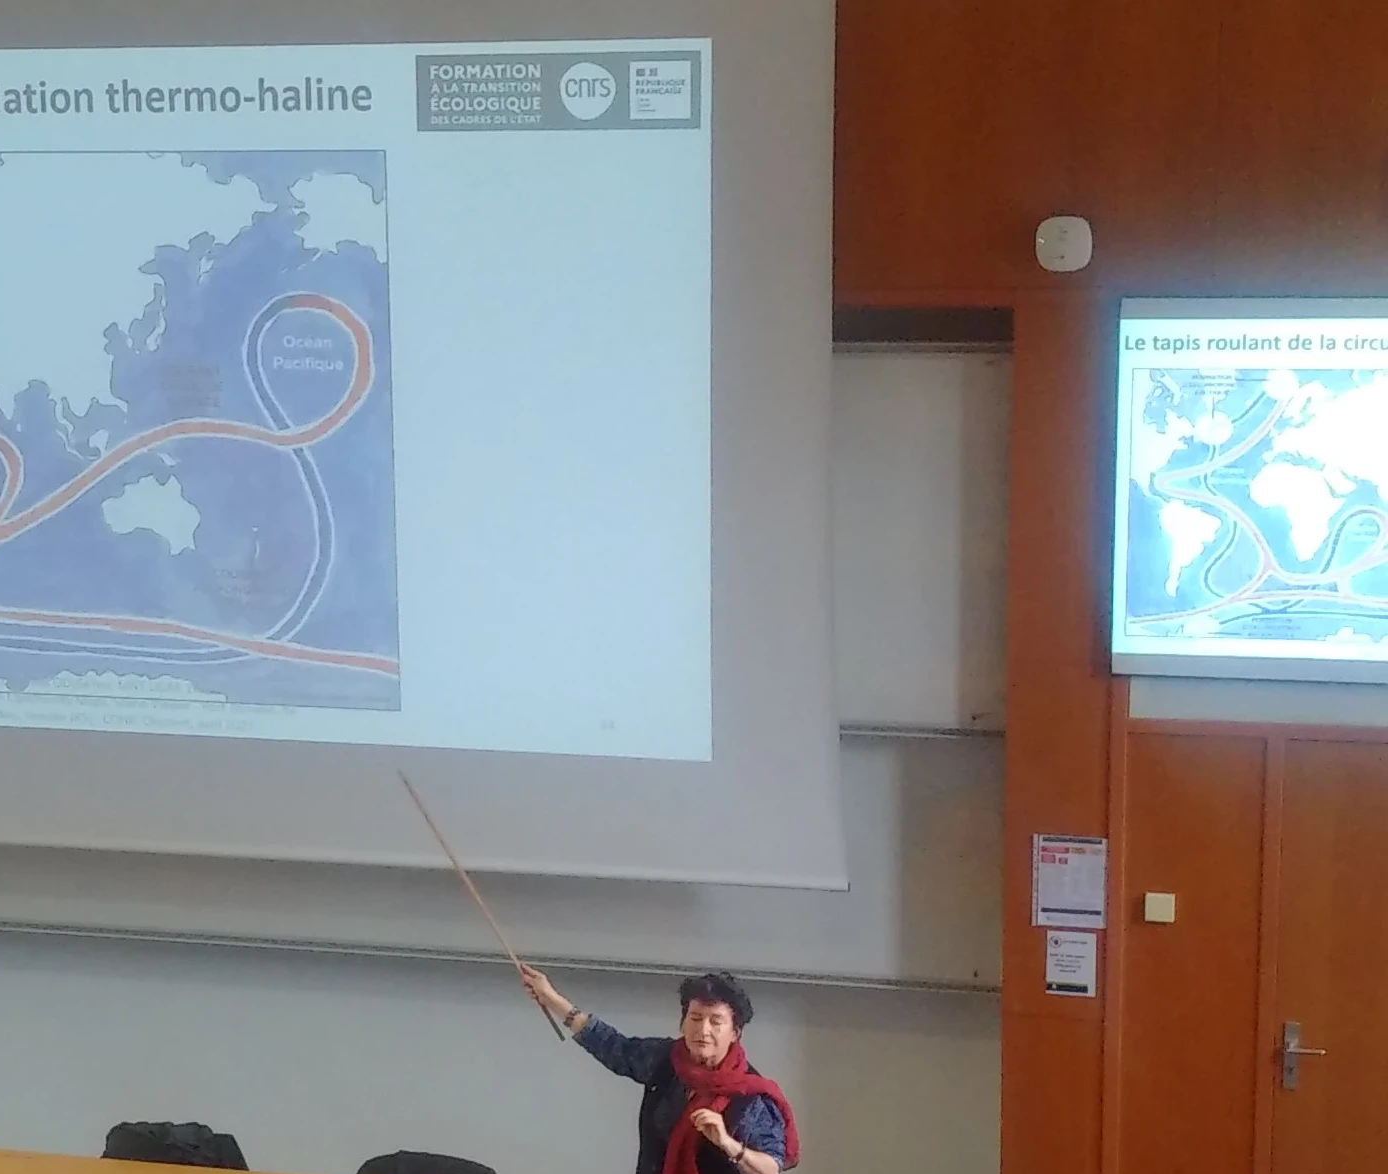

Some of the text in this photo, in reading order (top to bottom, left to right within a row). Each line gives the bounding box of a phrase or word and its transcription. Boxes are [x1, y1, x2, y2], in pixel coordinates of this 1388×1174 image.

[429, 64, 542, 80] FORMATION
[105, 76, 372, 113] thermo-haline
[443, 82, 459, 93] LA
[463, 81, 542, 93] TRANSITION
[430, 93, 542, 113] ÉCOLOGIQUE
[1124, 334, 1146, 351] Le
[1152, 333, 1201, 354] tapis
[1207, 333, 1281, 351] roulant
[1288, 333, 1313, 351] de
[1320, 333, 1337, 351] la
[273, 356, 344, 372] Pacifique
